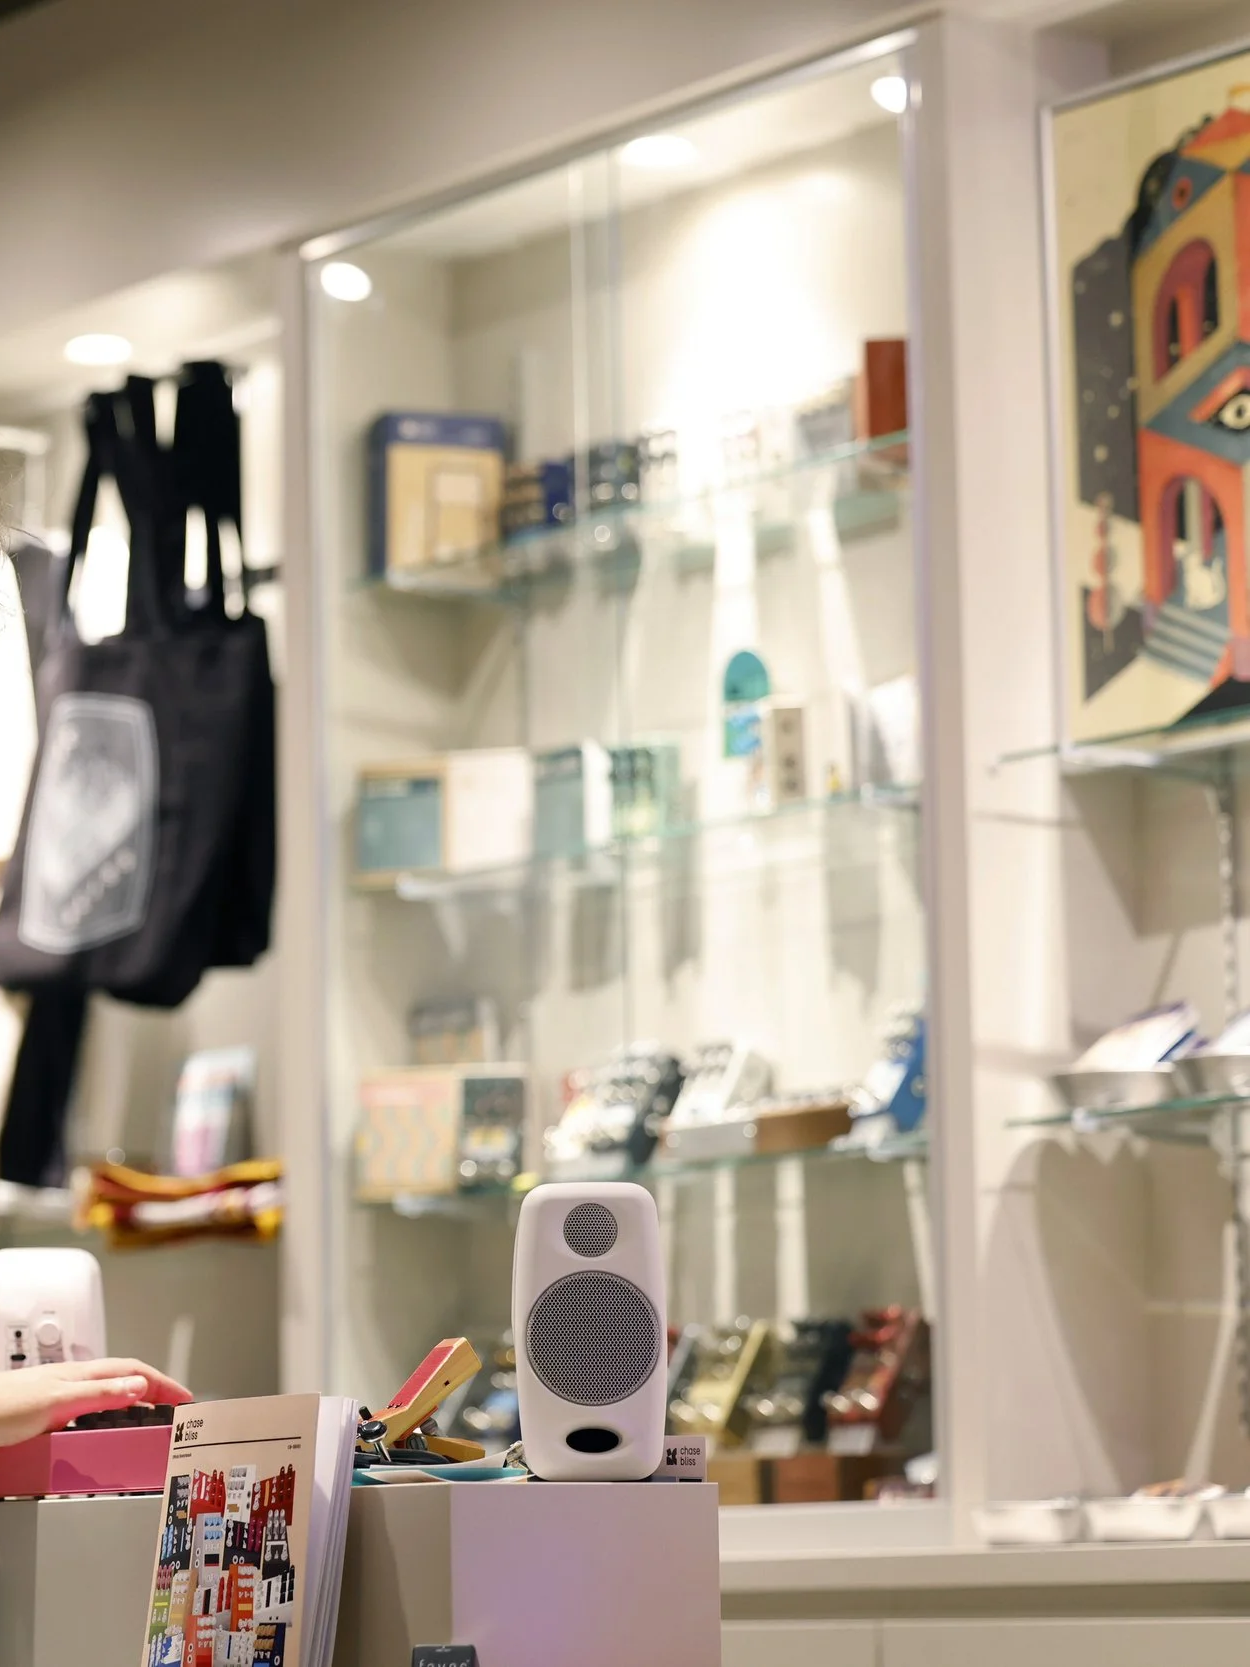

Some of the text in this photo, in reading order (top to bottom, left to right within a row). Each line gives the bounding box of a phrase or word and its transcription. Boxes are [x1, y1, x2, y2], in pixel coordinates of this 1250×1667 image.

[186, 1418, 204, 1429] chase
[184, 1431, 198, 1441] bliss
[680, 1445, 701, 1456] chase
[680, 1456, 696, 1466] bliss
